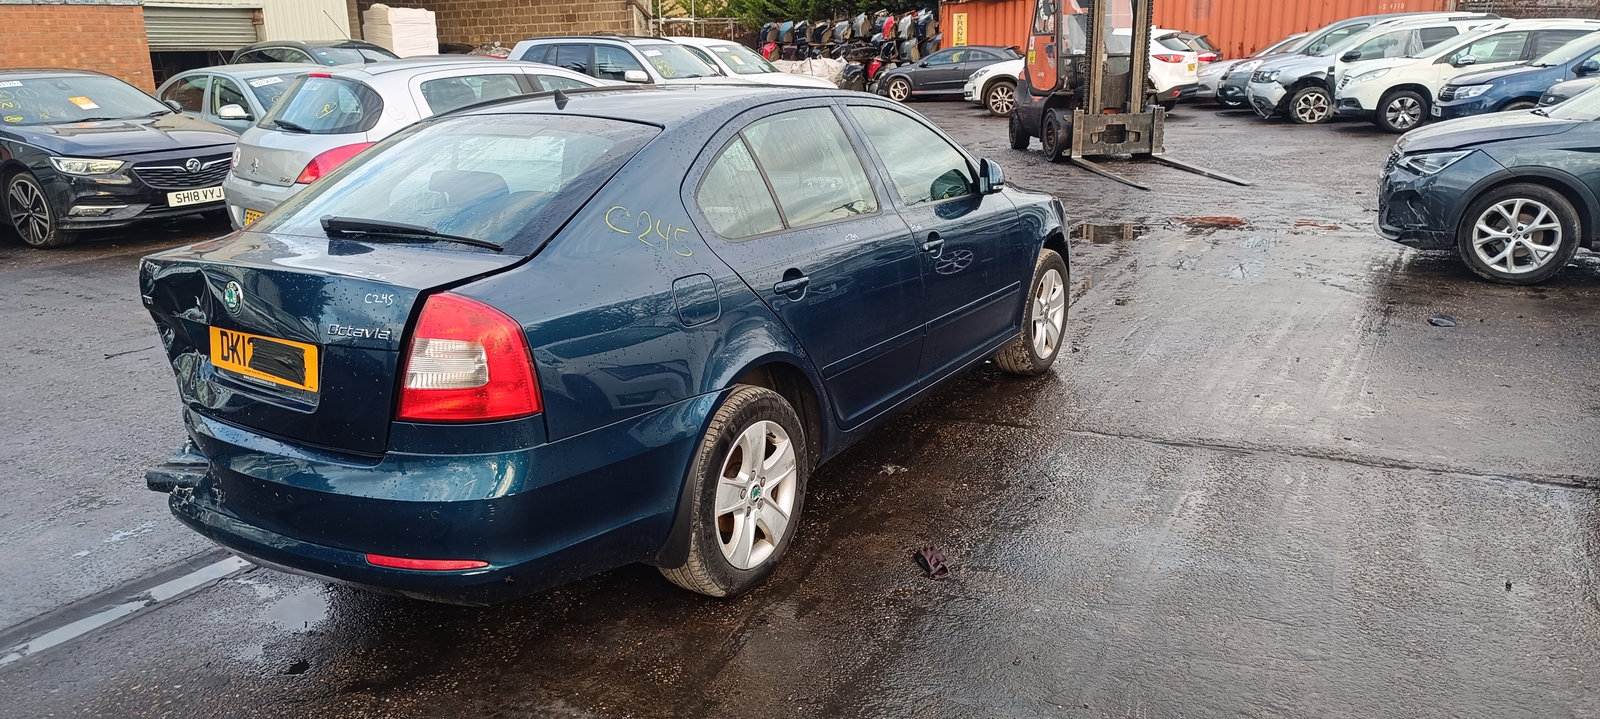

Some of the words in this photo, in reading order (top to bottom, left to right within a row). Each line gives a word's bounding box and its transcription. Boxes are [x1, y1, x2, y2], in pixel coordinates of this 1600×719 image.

[175, 191, 200, 203] SH18
[203, 188, 223, 200] VYJ
[605, 205, 694, 257] C245
[364, 293, 394, 306] C245
[327, 323, 391, 340] Octavia
